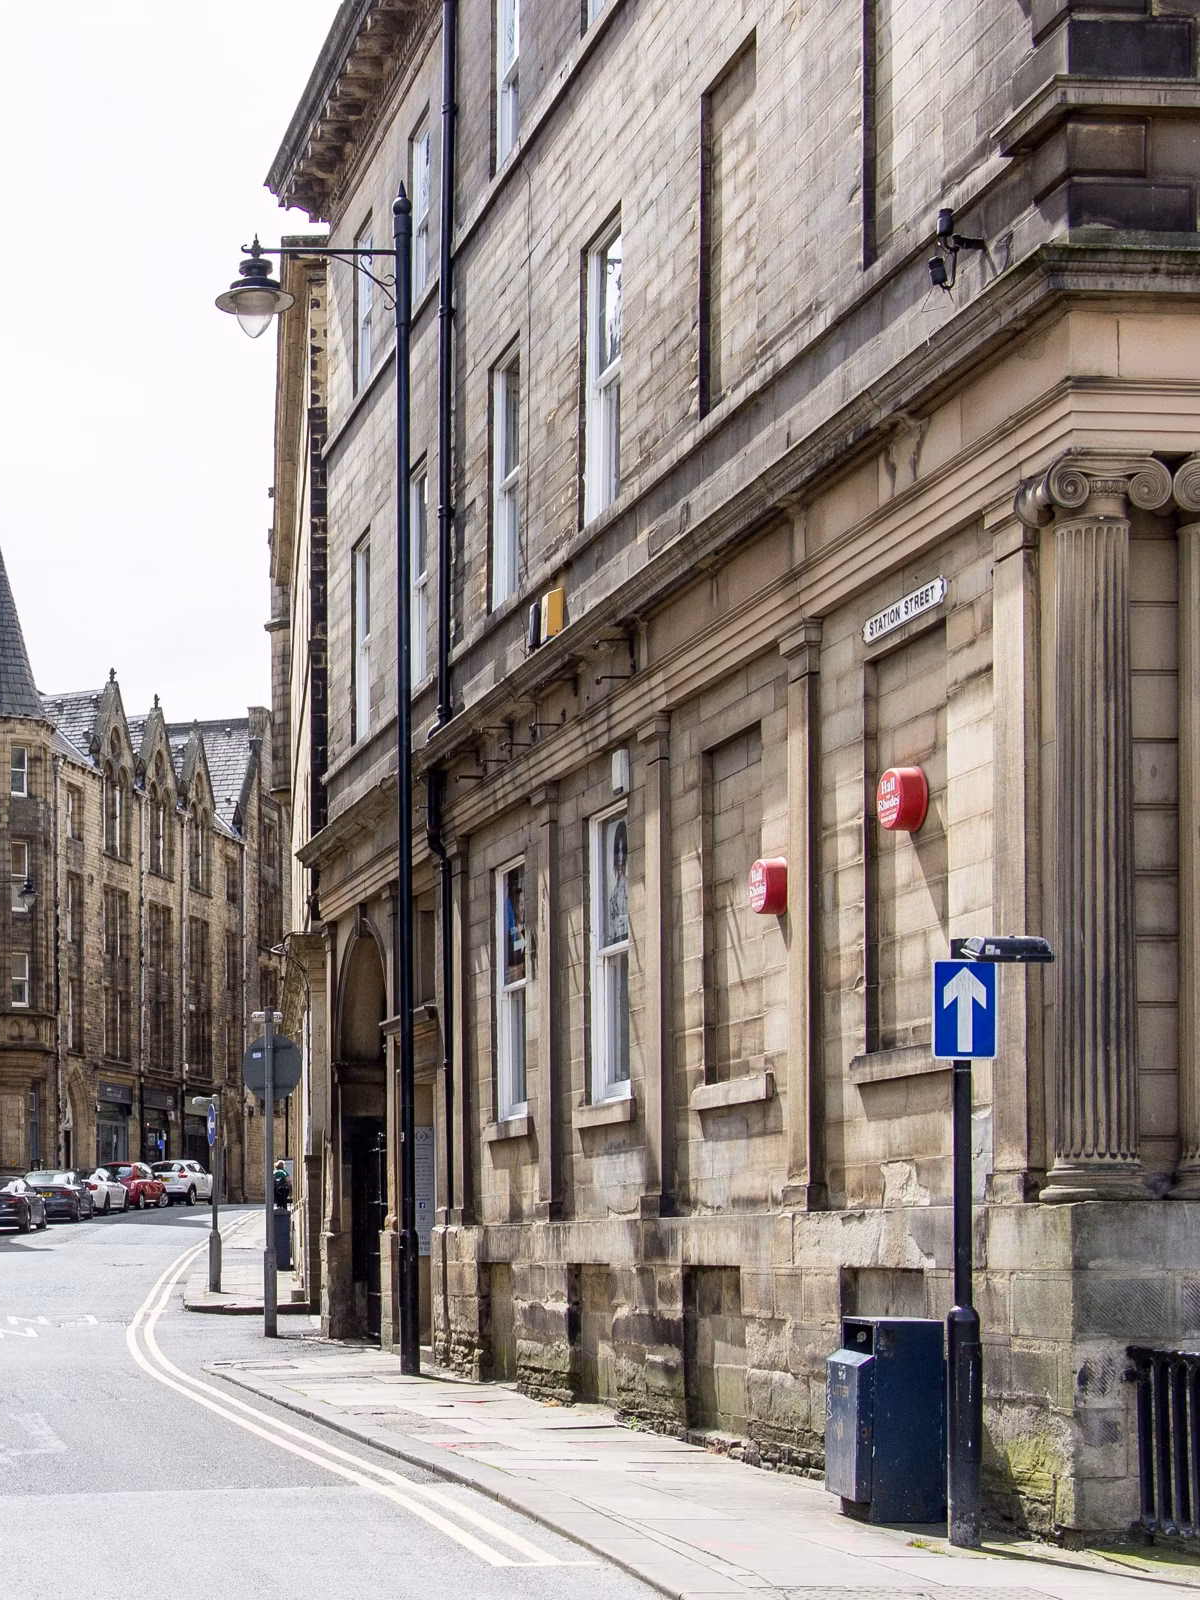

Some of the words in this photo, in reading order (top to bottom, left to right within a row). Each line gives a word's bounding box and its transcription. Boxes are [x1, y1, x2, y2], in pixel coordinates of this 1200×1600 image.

[869, 604, 900, 636] STATION
[904, 585, 935, 615] STREET
[881, 777, 895, 794] Hall
[751, 868, 763, 882] Hall
